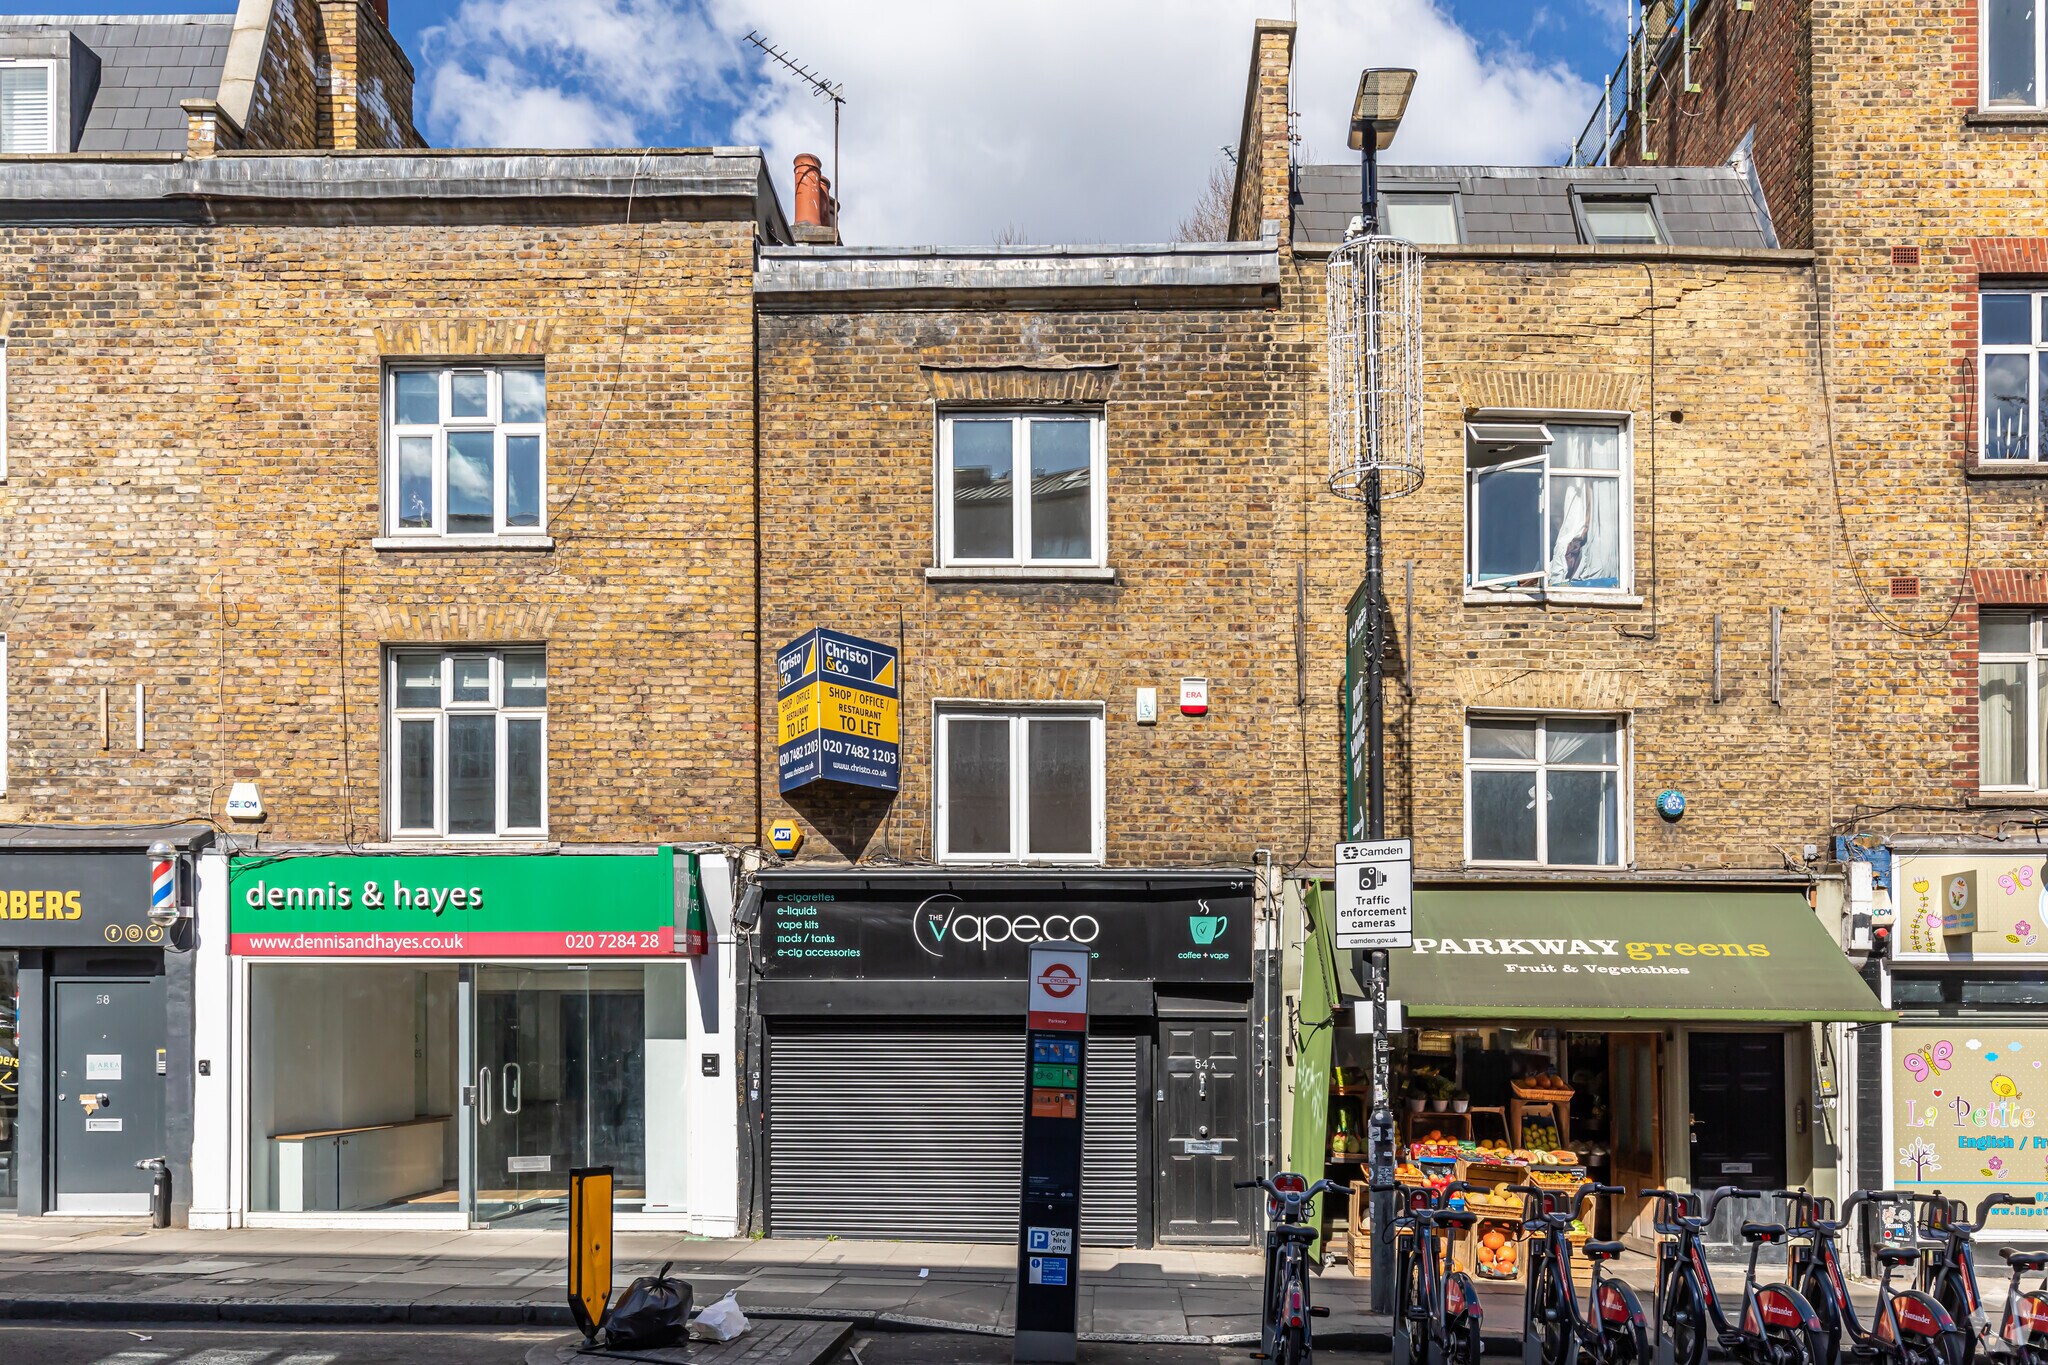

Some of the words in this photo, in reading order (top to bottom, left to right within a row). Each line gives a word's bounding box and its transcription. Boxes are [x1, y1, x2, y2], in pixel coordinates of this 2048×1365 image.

[825, 642, 868, 665] Christo
[780, 652, 801, 673] Christo
[826, 656, 849, 674] &Co
[780, 672, 791, 687] &Co
[782, 696, 793, 712] SHOP
[796, 689, 811, 705] OFFICE
[829, 686, 852, 700] SHOP
[854, 691, 858, 704] /
[859, 694, 885, 709] OFFICE
[886, 700, 890, 712] /
[786, 704, 809, 721] RESTAURANT
[838, 704, 882, 720] RESTAURANT
[787, 723, 796, 739] TO
[796, 716, 808, 735] LET
[840, 714, 856, 732] TO
[860, 720, 880, 737] LET
[780, 752, 790, 767] 020
[790, 743, 804, 762] 7482
[804, 738, 818, 756] 1203
[822, 738, 842, 754] 020
[845, 743, 870, 760] 7482
[872, 749, 896, 765] 1203
[832, 762, 888, 778] www.christo.co.uk
[229, 800, 257, 809] SECOM
[775, 830, 791, 840] ADT
[1360, 846, 1403, 857] Camden
[246, 880, 352, 908] dennis
[361, 880, 384, 908] &
[394, 880, 483, 916] hayes
[777, 893, 835, 903] e-cigarettes
[1356, 896, 1390, 906] Traffic
[777, 906, 817, 916] e-liquids
[1340, 906, 1407, 918] enforcement
[777, 921, 802, 930] vape
[804, 920, 819, 928] kits
[1351, 920, 1396, 928] cameras
[250, 934, 464, 952] www.dennisandhayes.co.uk
[565, 934, 594, 948] 020
[598, 934, 636, 948] 7284
[640, 934, 660, 948] 28
[777, 934, 802, 942] mods
[803, 934, 810, 943] /
[811, 934, 835, 942] tanks
[1350, 937, 1398, 946] camden.gov.uk
[777, 948, 803, 958] e-cig
[804, 948, 860, 958] accessories
[1178, 951, 1202, 959] coffee
[1210, 952, 1229, 960] vape
[1412, 938, 1620, 956] PARKWAY
[1624, 941, 1771, 961] greens
[1504, 964, 1557, 974] Fruit
[1562, 965, 1578, 974] &
[1582, 964, 1690, 976] Vegetables
[96, 994, 110, 1005] 58
[1194, 1060, 1209, 1070] 54
[1211, 1062, 1217, 1070] A
[1906, 1099, 1938, 1128] La
[1948, 1096, 2036, 1128] Petite
[1958, 1135, 2014, 1150] English
[2018, 1136, 2028, 1150] /
[2033, 1136, 2048, 1150] Fr
[1034, 1232, 1046, 1247] P
[1050, 1230, 1070, 1238] Cycle
[1768, 1304, 1793, 1316] Santander
[1904, 1310, 1930, 1324] Santander
